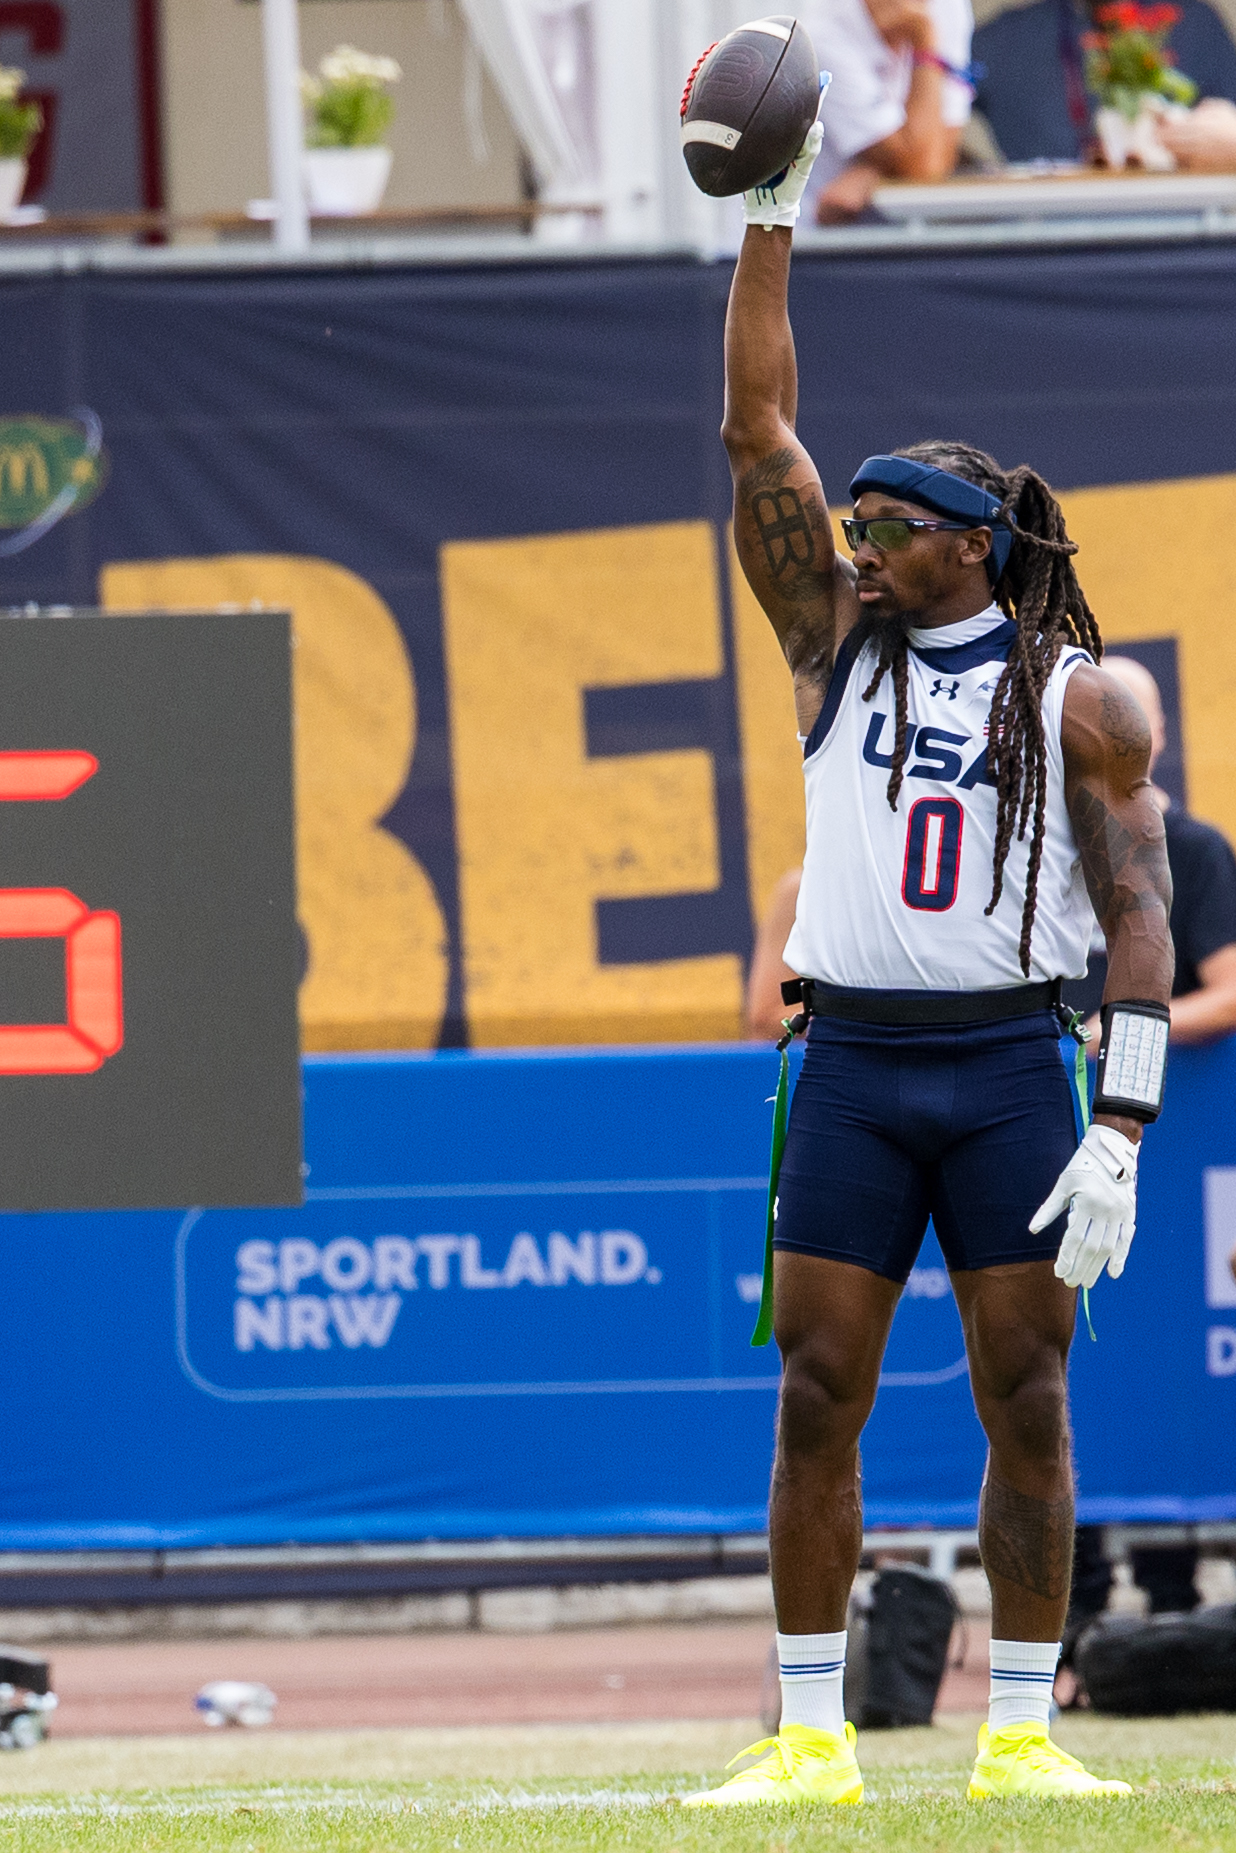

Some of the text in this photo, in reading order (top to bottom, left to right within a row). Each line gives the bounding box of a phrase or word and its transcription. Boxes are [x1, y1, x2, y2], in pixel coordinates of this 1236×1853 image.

[901, 796, 964, 912] 0
[235, 1229, 663, 1296] SPORTLAND.
[234, 1292, 401, 1352] NRW
